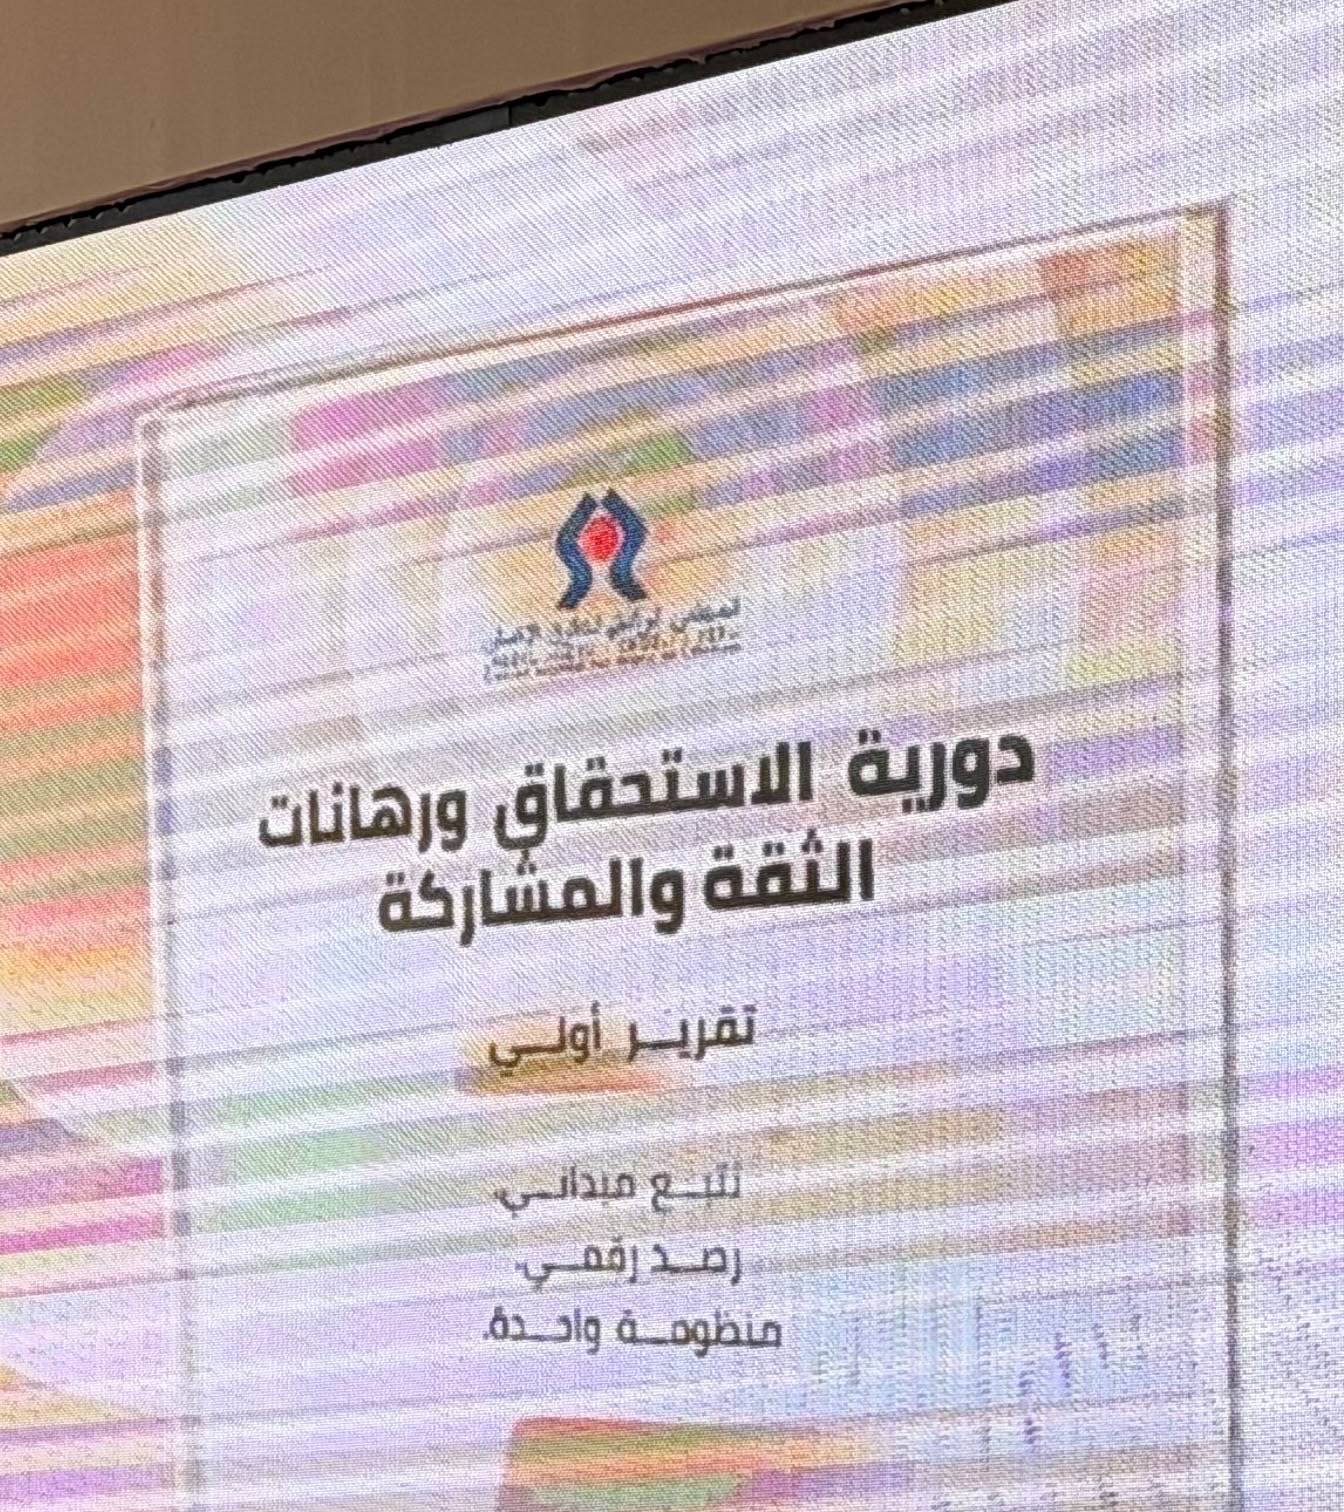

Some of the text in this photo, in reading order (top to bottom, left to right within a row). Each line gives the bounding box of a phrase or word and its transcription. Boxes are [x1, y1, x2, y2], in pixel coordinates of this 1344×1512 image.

[258, 728, 1036, 853] دورية الاستحقاق ورهانات
[378, 838, 875, 946] الثقة والمشاركة
[489, 1000, 758, 1077] تقرير أولي
[650, 1243, 742, 1285] رصد
[616, 1308, 782, 1357] منظومة
